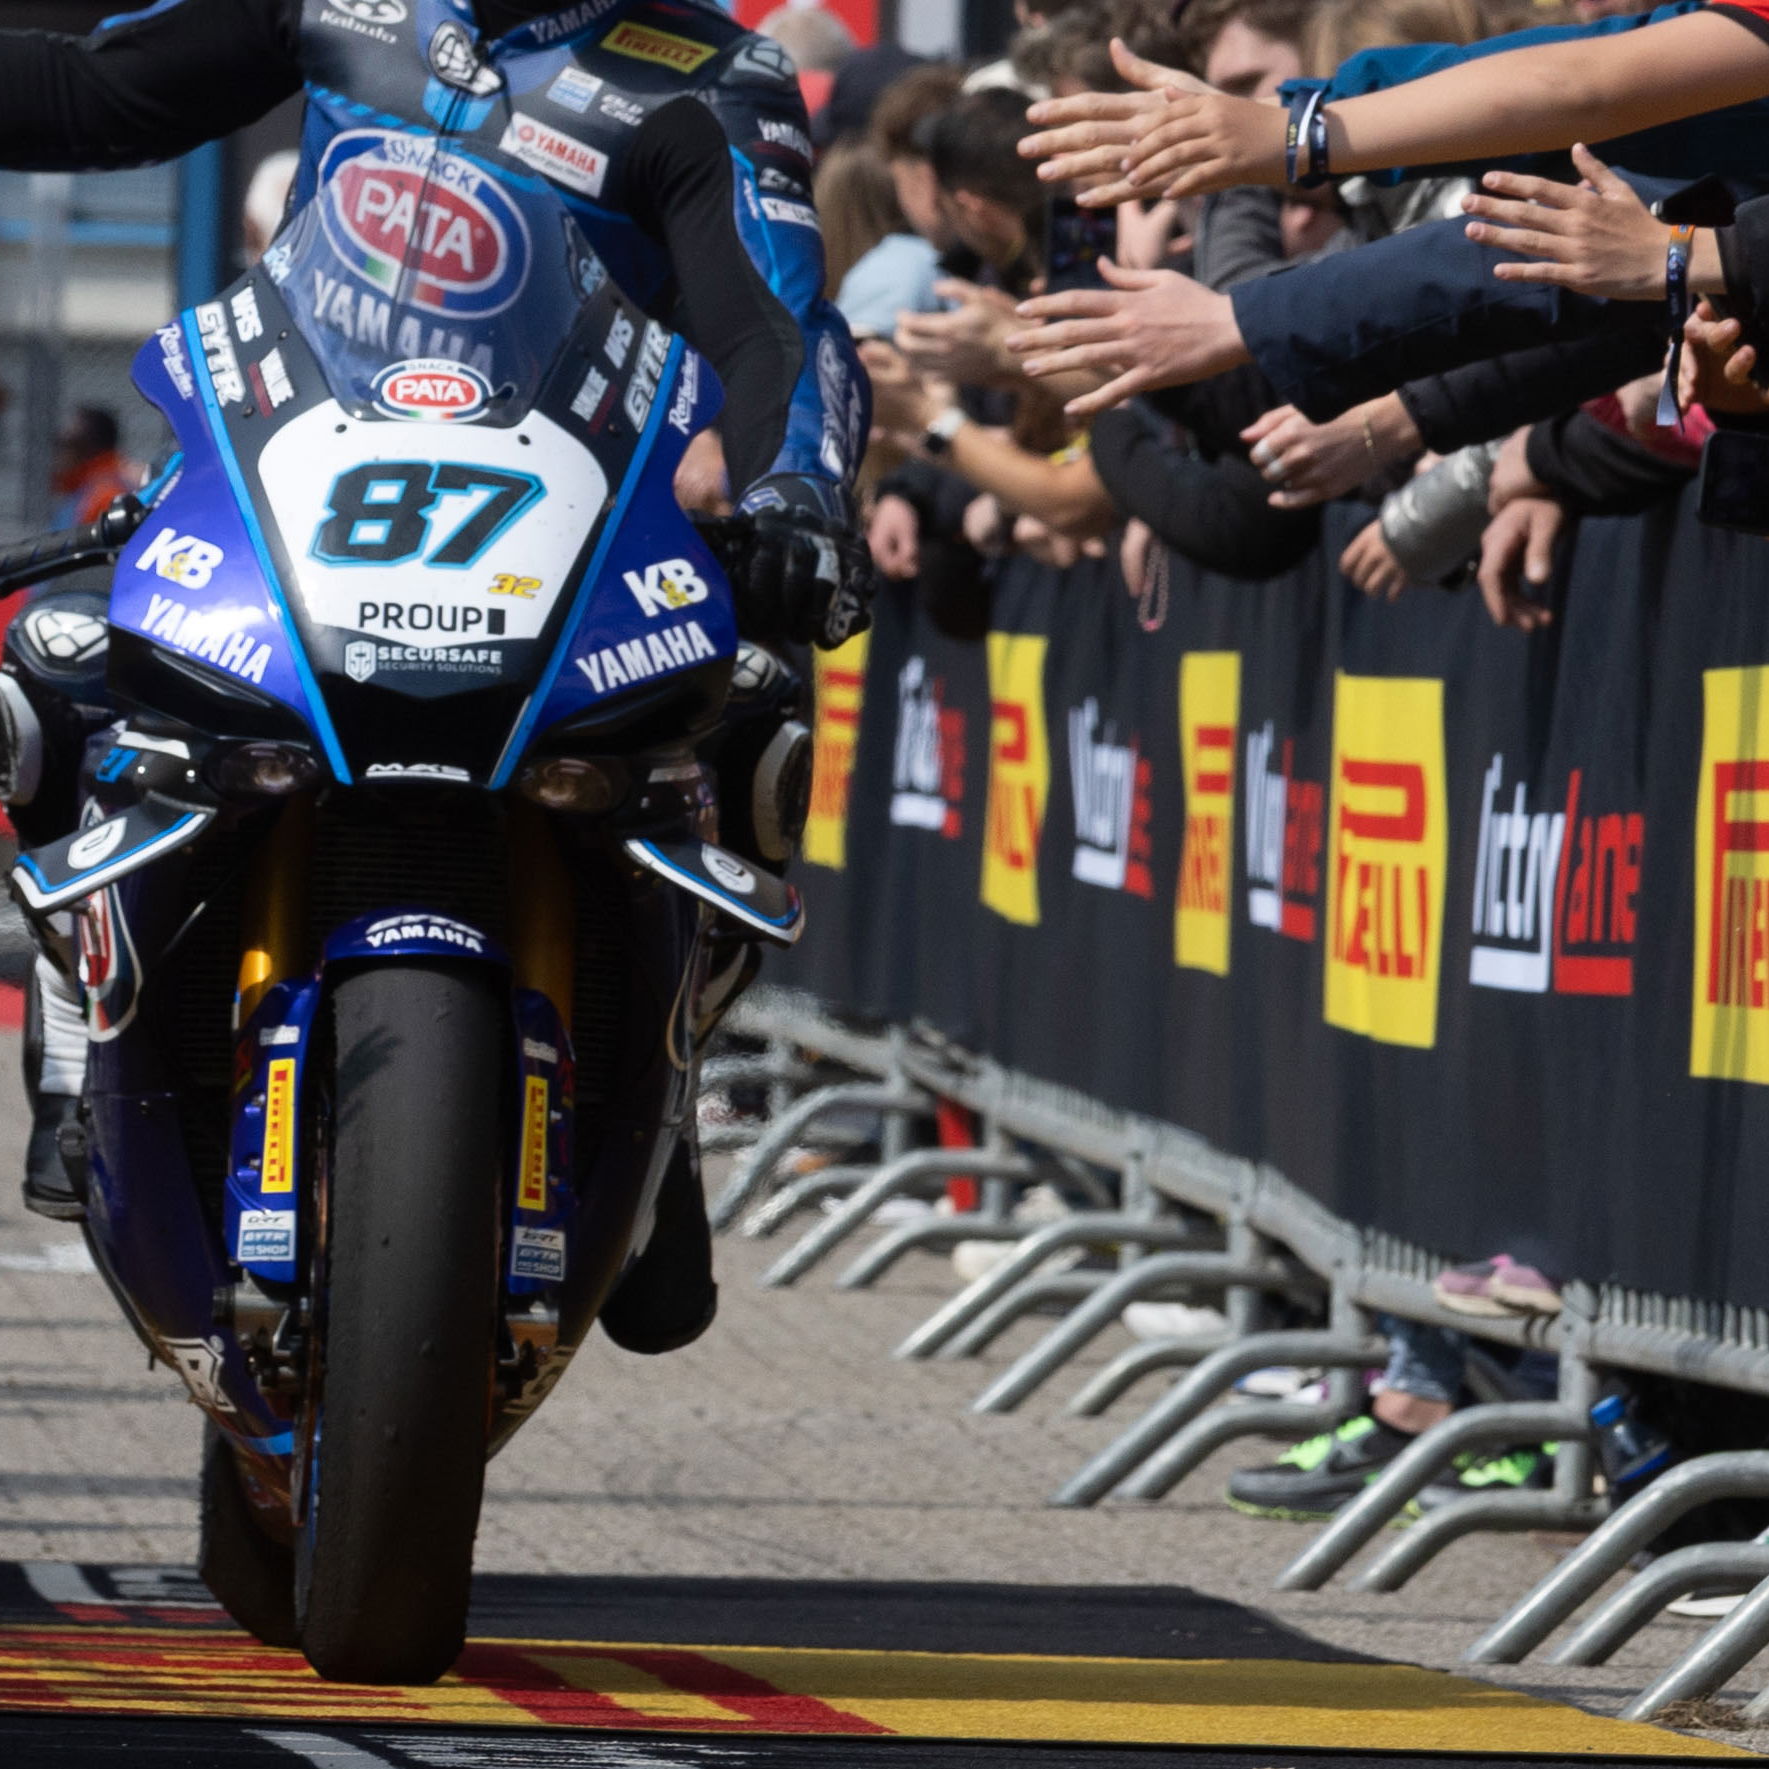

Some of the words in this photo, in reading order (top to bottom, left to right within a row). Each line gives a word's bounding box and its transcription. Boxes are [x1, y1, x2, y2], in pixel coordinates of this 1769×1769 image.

[536, 133, 598, 175] YAMAHA
[356, 178, 475, 273] PATA
[313, 268, 494, 381] YAMAHA
[195, 301, 247, 408] GYTR
[408, 362, 456, 372] SNACK
[395, 379, 468, 404] PATA
[623, 318, 672, 434] GYTR
[306, 460, 549, 571] 87
[487, 573, 543, 599] 32
[358, 601, 483, 633] PROUP
[140, 593, 273, 684] YAMAHA
[378, 646, 503, 664] SECURSAFE
[575, 620, 718, 694] YAMAHA
[378, 662, 434, 673] SECURITY
[436, 663, 503, 675] SOLUTIONS
[365, 924, 484, 954] YAMAHA
